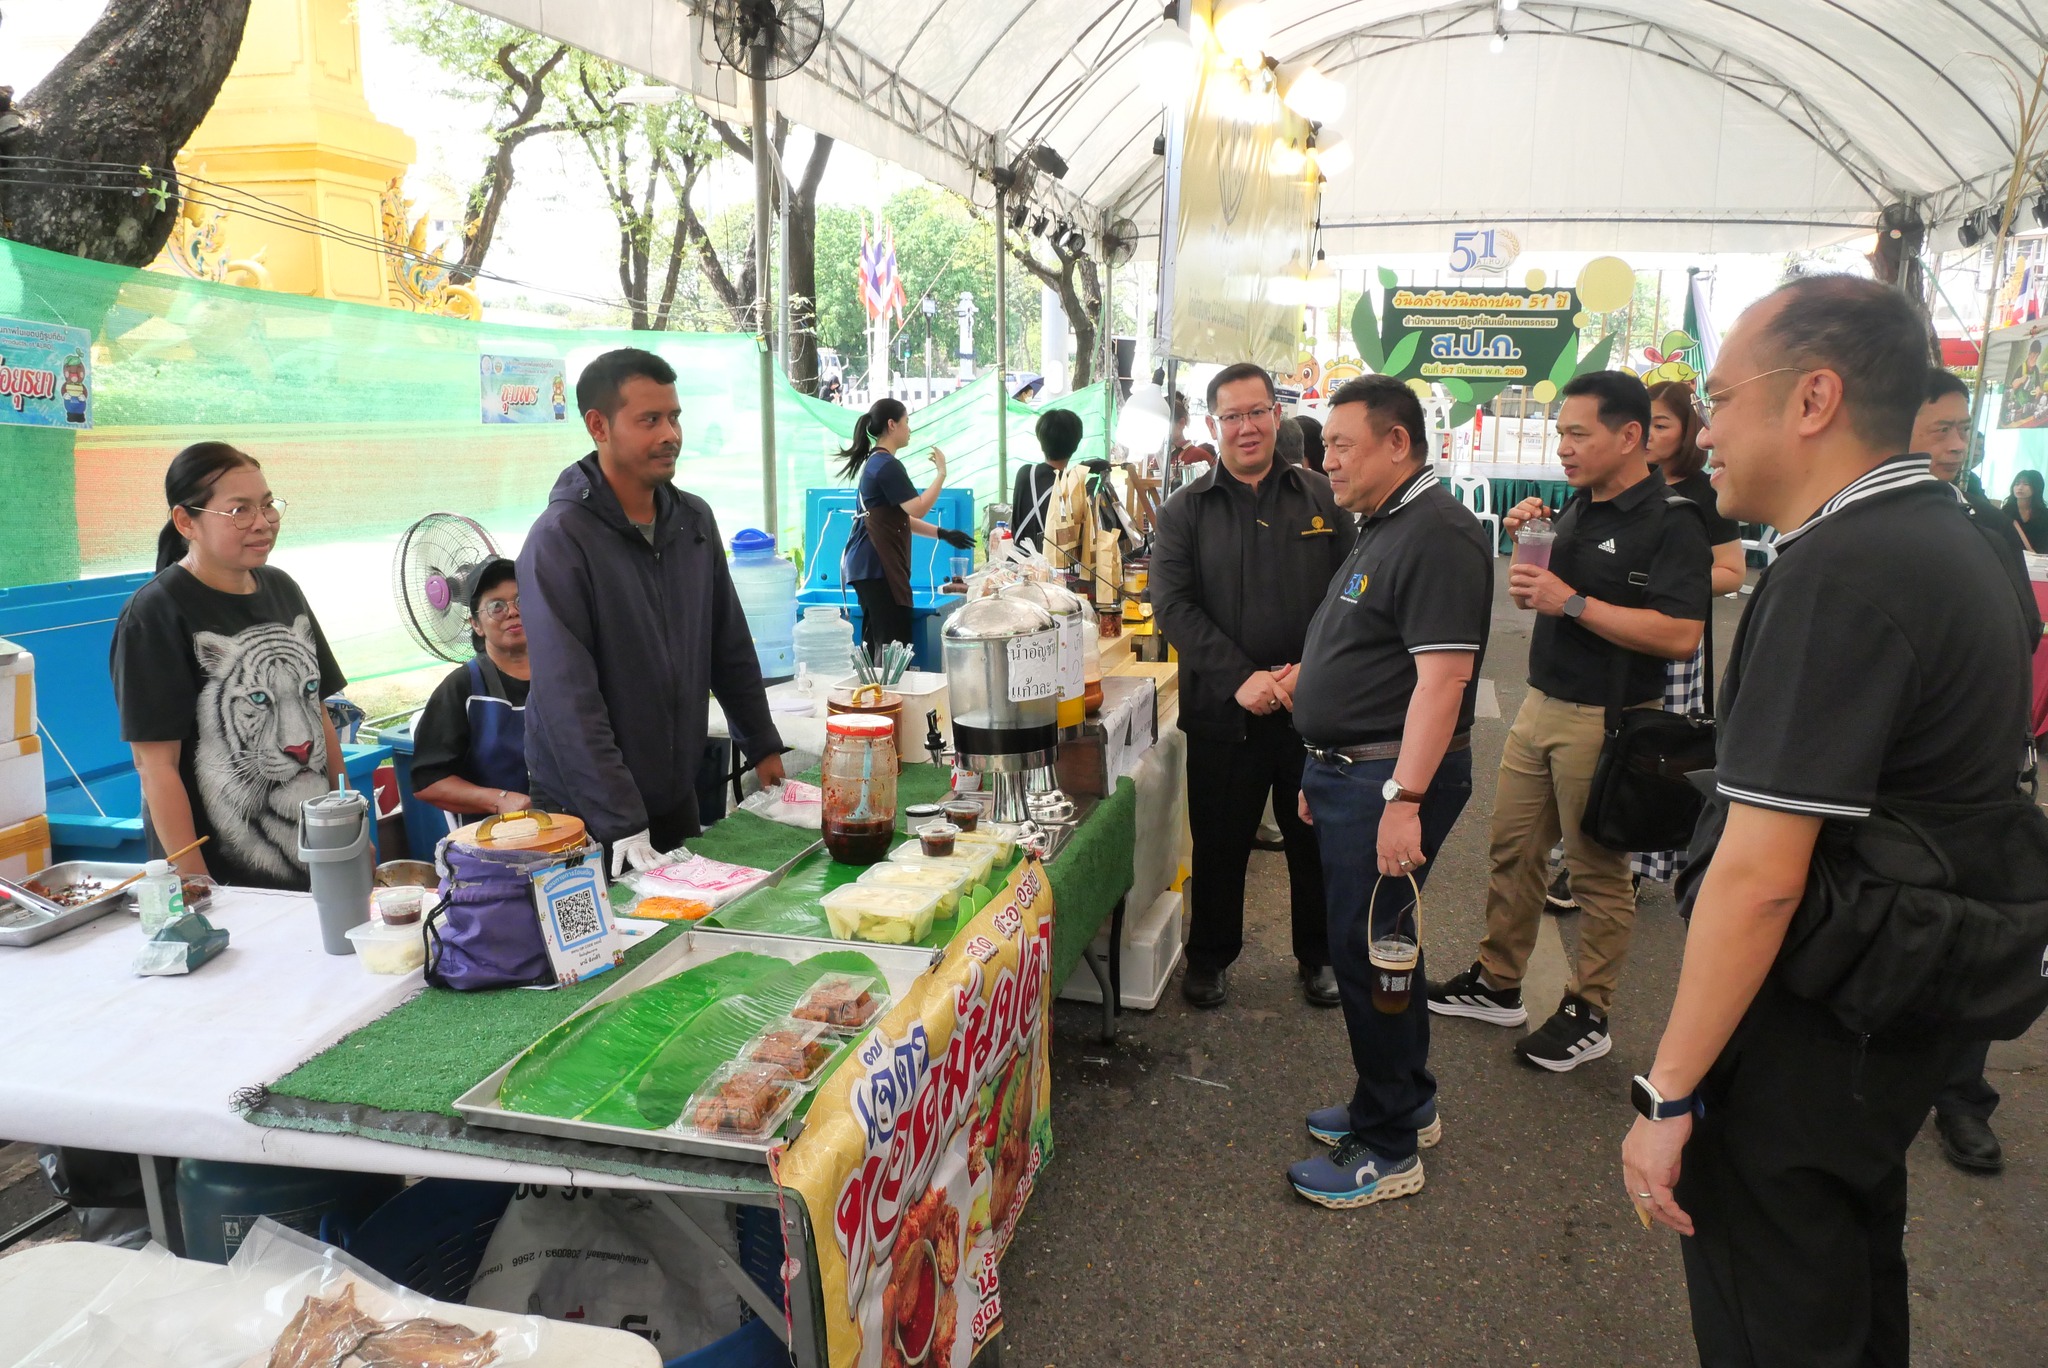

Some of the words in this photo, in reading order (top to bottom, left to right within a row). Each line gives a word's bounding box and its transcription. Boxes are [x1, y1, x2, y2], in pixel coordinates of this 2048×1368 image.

[1449, 229, 1497, 273] 51
[1395, 292, 1521, 308] วันคล้ายวันสถาปนา
[1528, 297, 1548, 309] 51
[1556, 293, 1569, 309] ปี
[1404, 314, 1556, 328] สำนักงานการปฏิรูปที่ดินเพื่อเกษตรกรรม
[1433, 331, 1521, 357] ส.ป.ก.
[1422, 364, 1439, 374] วันที่
[1441, 367, 1454, 375] 5-7
[1456, 365, 1482, 376] มีนาคม
[1505, 367, 1524, 376] 2569
[0, 354, 54, 411] อยุธยา
[994, 901, 1023, 935] สะอ
[512, 1251, 535, 1267] 2566
